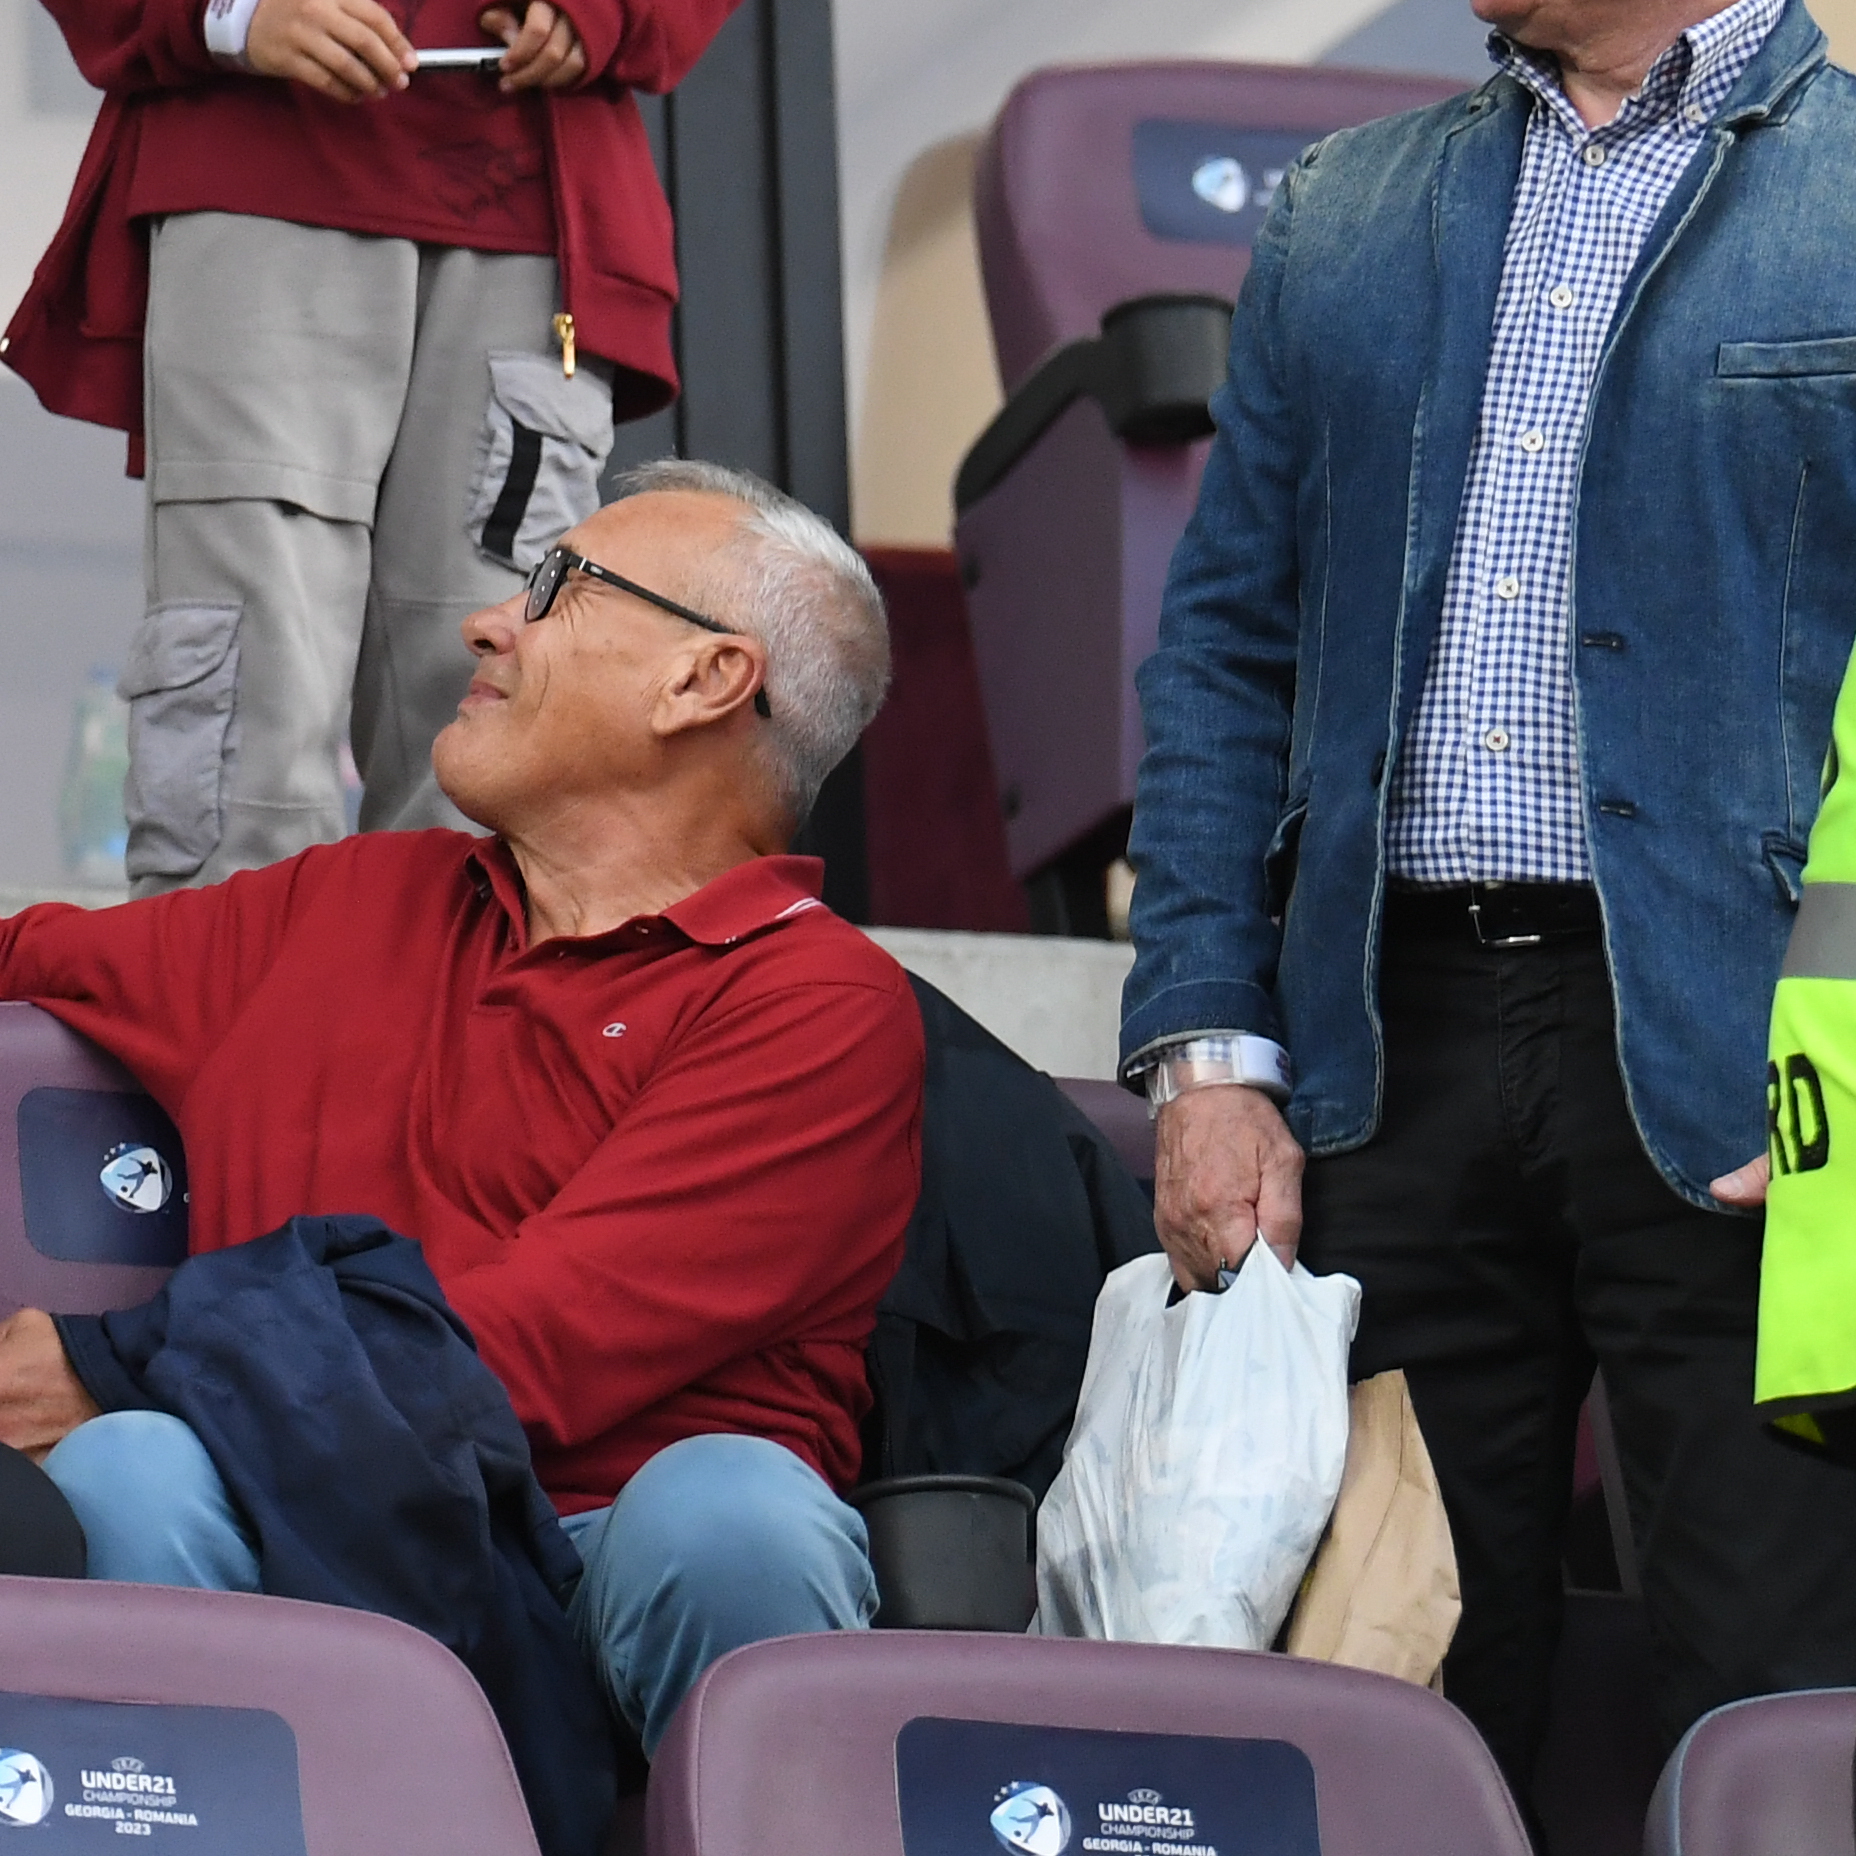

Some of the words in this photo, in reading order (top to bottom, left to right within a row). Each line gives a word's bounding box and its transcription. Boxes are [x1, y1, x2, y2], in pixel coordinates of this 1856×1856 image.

[80, 1769, 177, 1794] UNDER21
[82, 1789, 178, 1808] CHAMPIONSHIP
[64, 1803, 126, 1820] GEORGIA
[133, 1808, 199, 1827] ROMANIA
[1098, 1802, 1195, 1827] UNDER21
[114, 1820, 152, 1836] 2023
[1100, 1822, 1196, 1841] CHAMPIONSHIP
[1082, 1837, 1143, 1853] GEORGIA
[1151, 1841, 1219, 1856] ROMANIA
